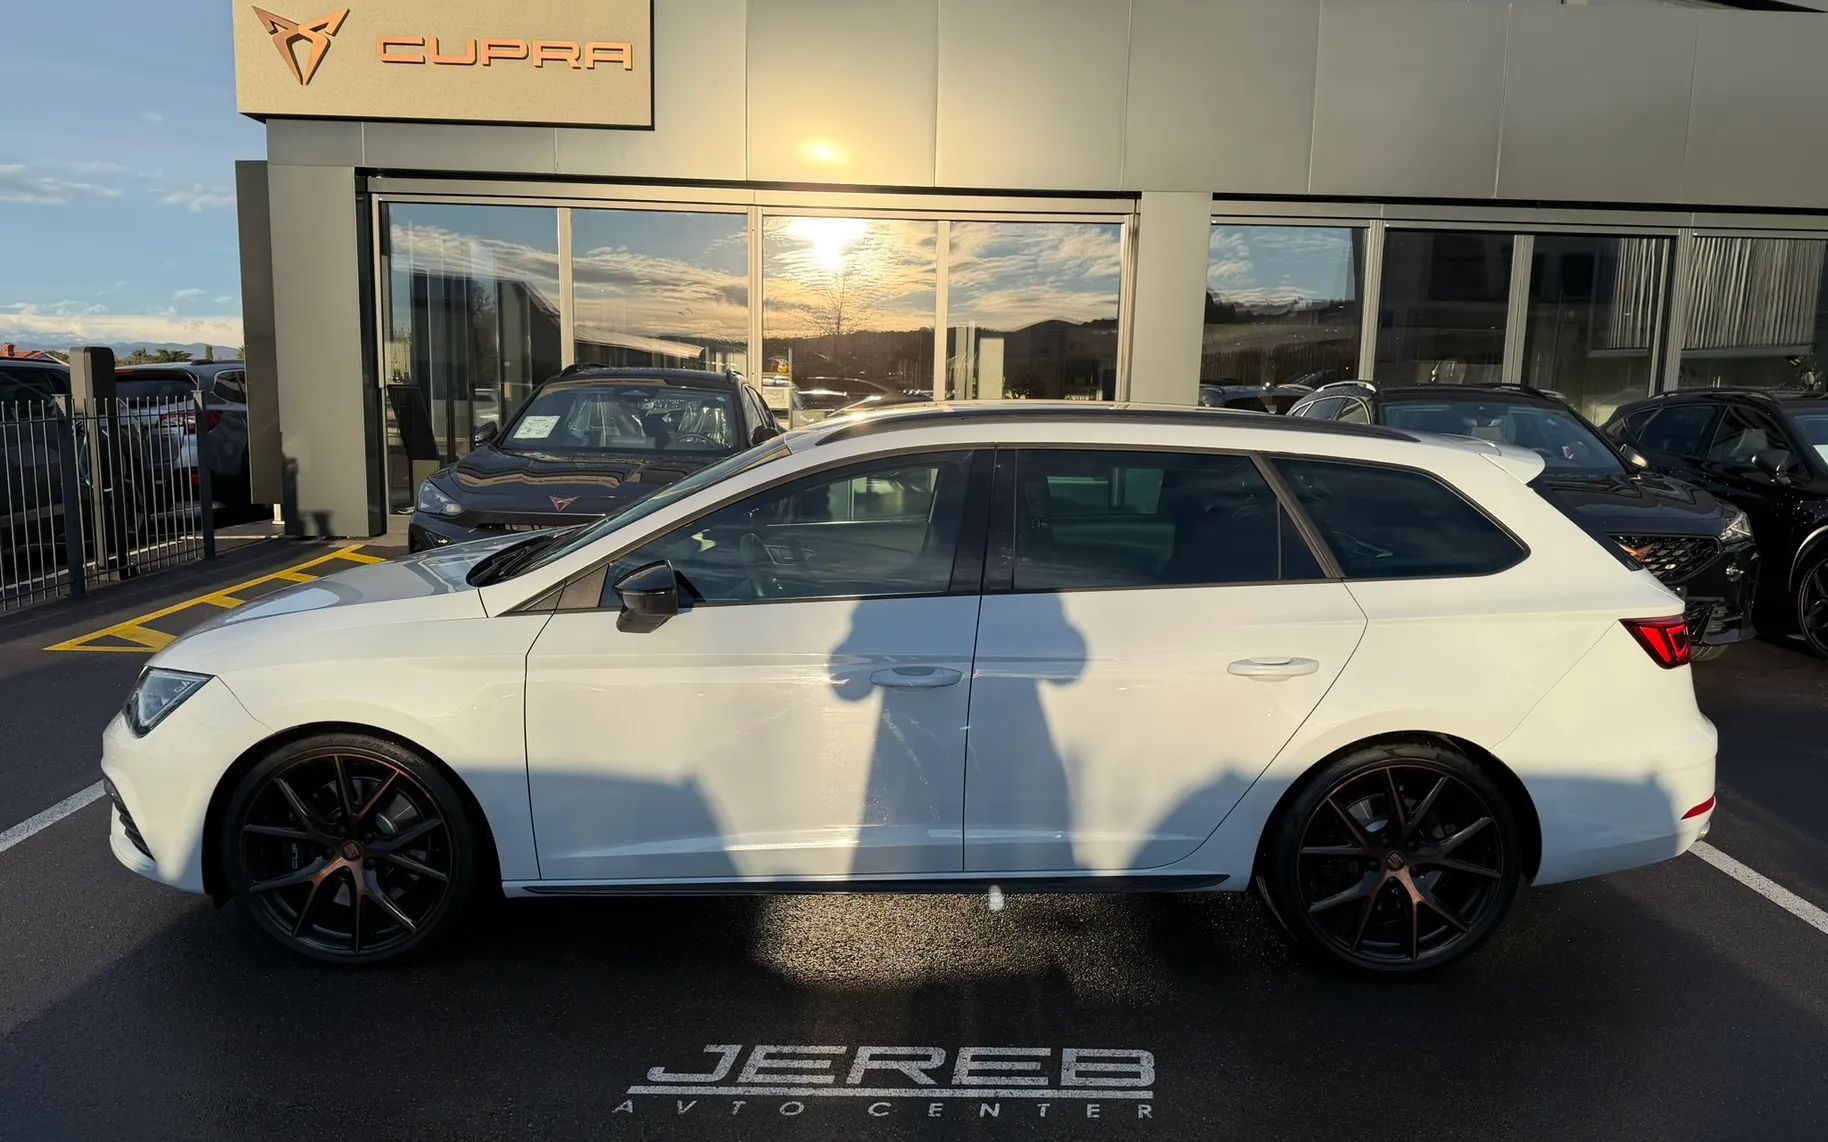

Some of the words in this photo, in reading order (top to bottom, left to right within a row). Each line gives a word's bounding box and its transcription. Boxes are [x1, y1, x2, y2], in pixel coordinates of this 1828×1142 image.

[376, 35, 633, 70] CUPRA
[646, 1044, 1156, 1087] JEREB
[611, 1099, 805, 1116] AVTO
[867, 1101, 1153, 1119] CENTER
